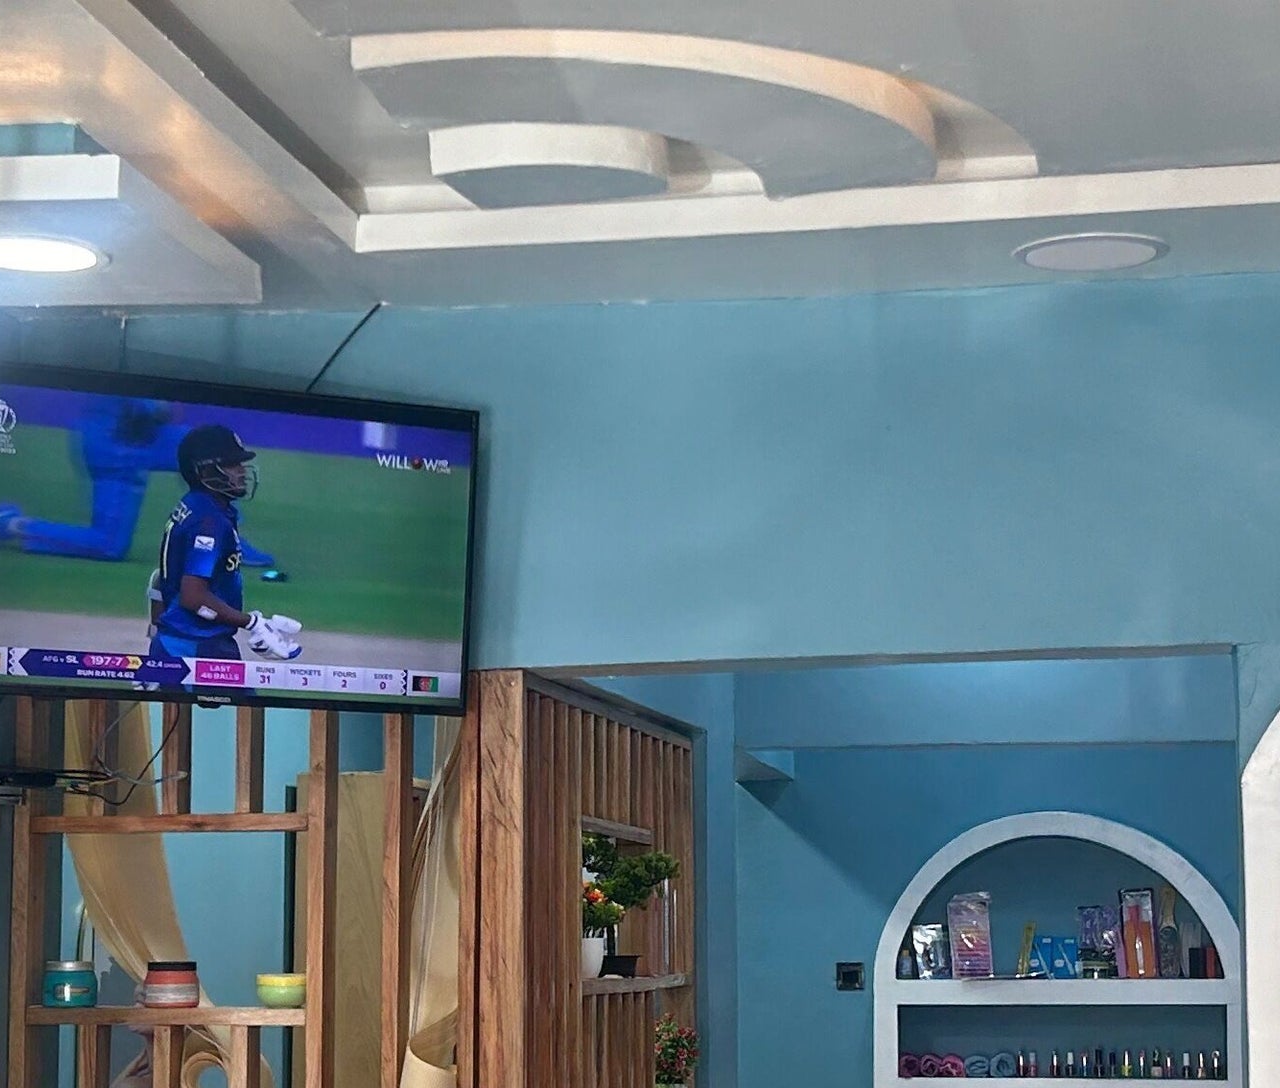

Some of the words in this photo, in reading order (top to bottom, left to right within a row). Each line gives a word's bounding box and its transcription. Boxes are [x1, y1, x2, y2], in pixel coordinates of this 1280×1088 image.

[65, 655, 79, 664] SL
[90, 655, 123, 666] 197-7
[146, 660, 163, 668] 42.4
[255, 666, 276, 674] RUNS
[290, 668, 321, 677] WICKETS
[218, 673, 240, 681] BALLS
[259, 675, 271, 684] 31
[332, 671, 357, 679] FOURS
[301, 677, 308, 686] 3
[341, 679, 347, 688] 2
[379, 681, 386, 690] 0
